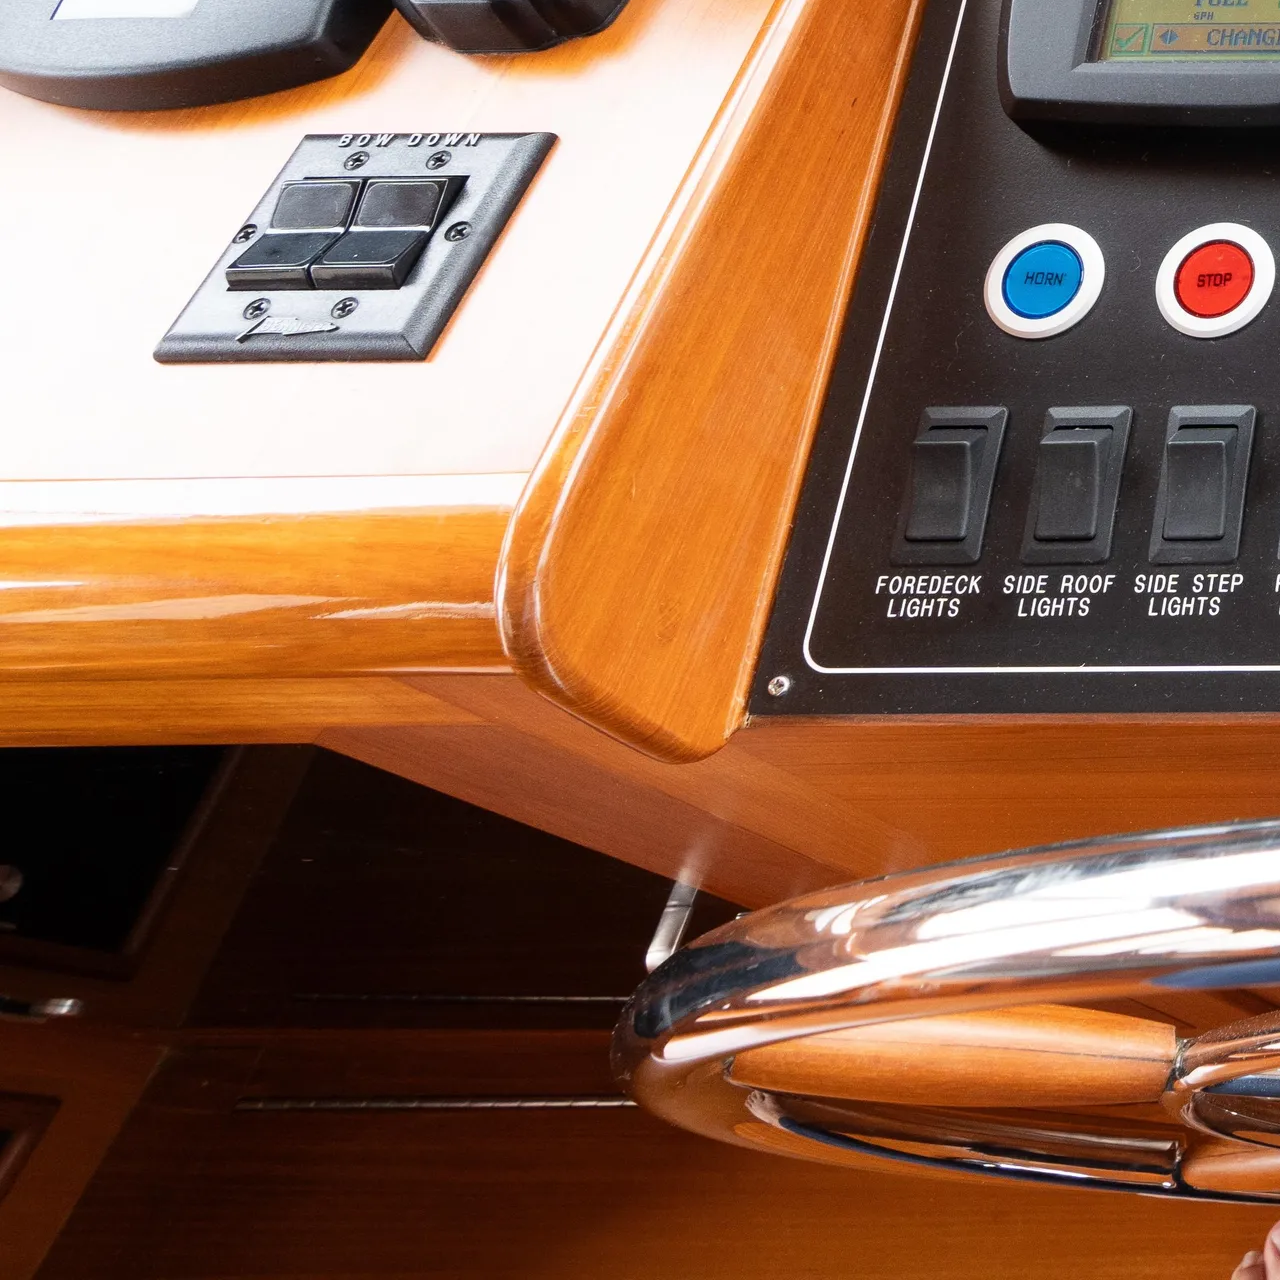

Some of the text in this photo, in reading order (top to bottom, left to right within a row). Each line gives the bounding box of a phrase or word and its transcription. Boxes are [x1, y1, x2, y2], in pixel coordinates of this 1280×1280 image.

[1193, 12, 1214, 20] GPH
[338, 133, 481, 147] BOW DOWN
[1024, 272, 1064, 286] HORN
[1196, 272, 1233, 288] STOP
[875, 575, 982, 595] FOREDECK
[1002, 574, 1116, 594] SIDE ROOF
[1134, 574, 1244, 594] SIDE STEP
[887, 598, 961, 617] LIGHTS
[1017, 597, 1091, 617] LIGHTS
[1148, 596, 1221, 616] LIGHTS
